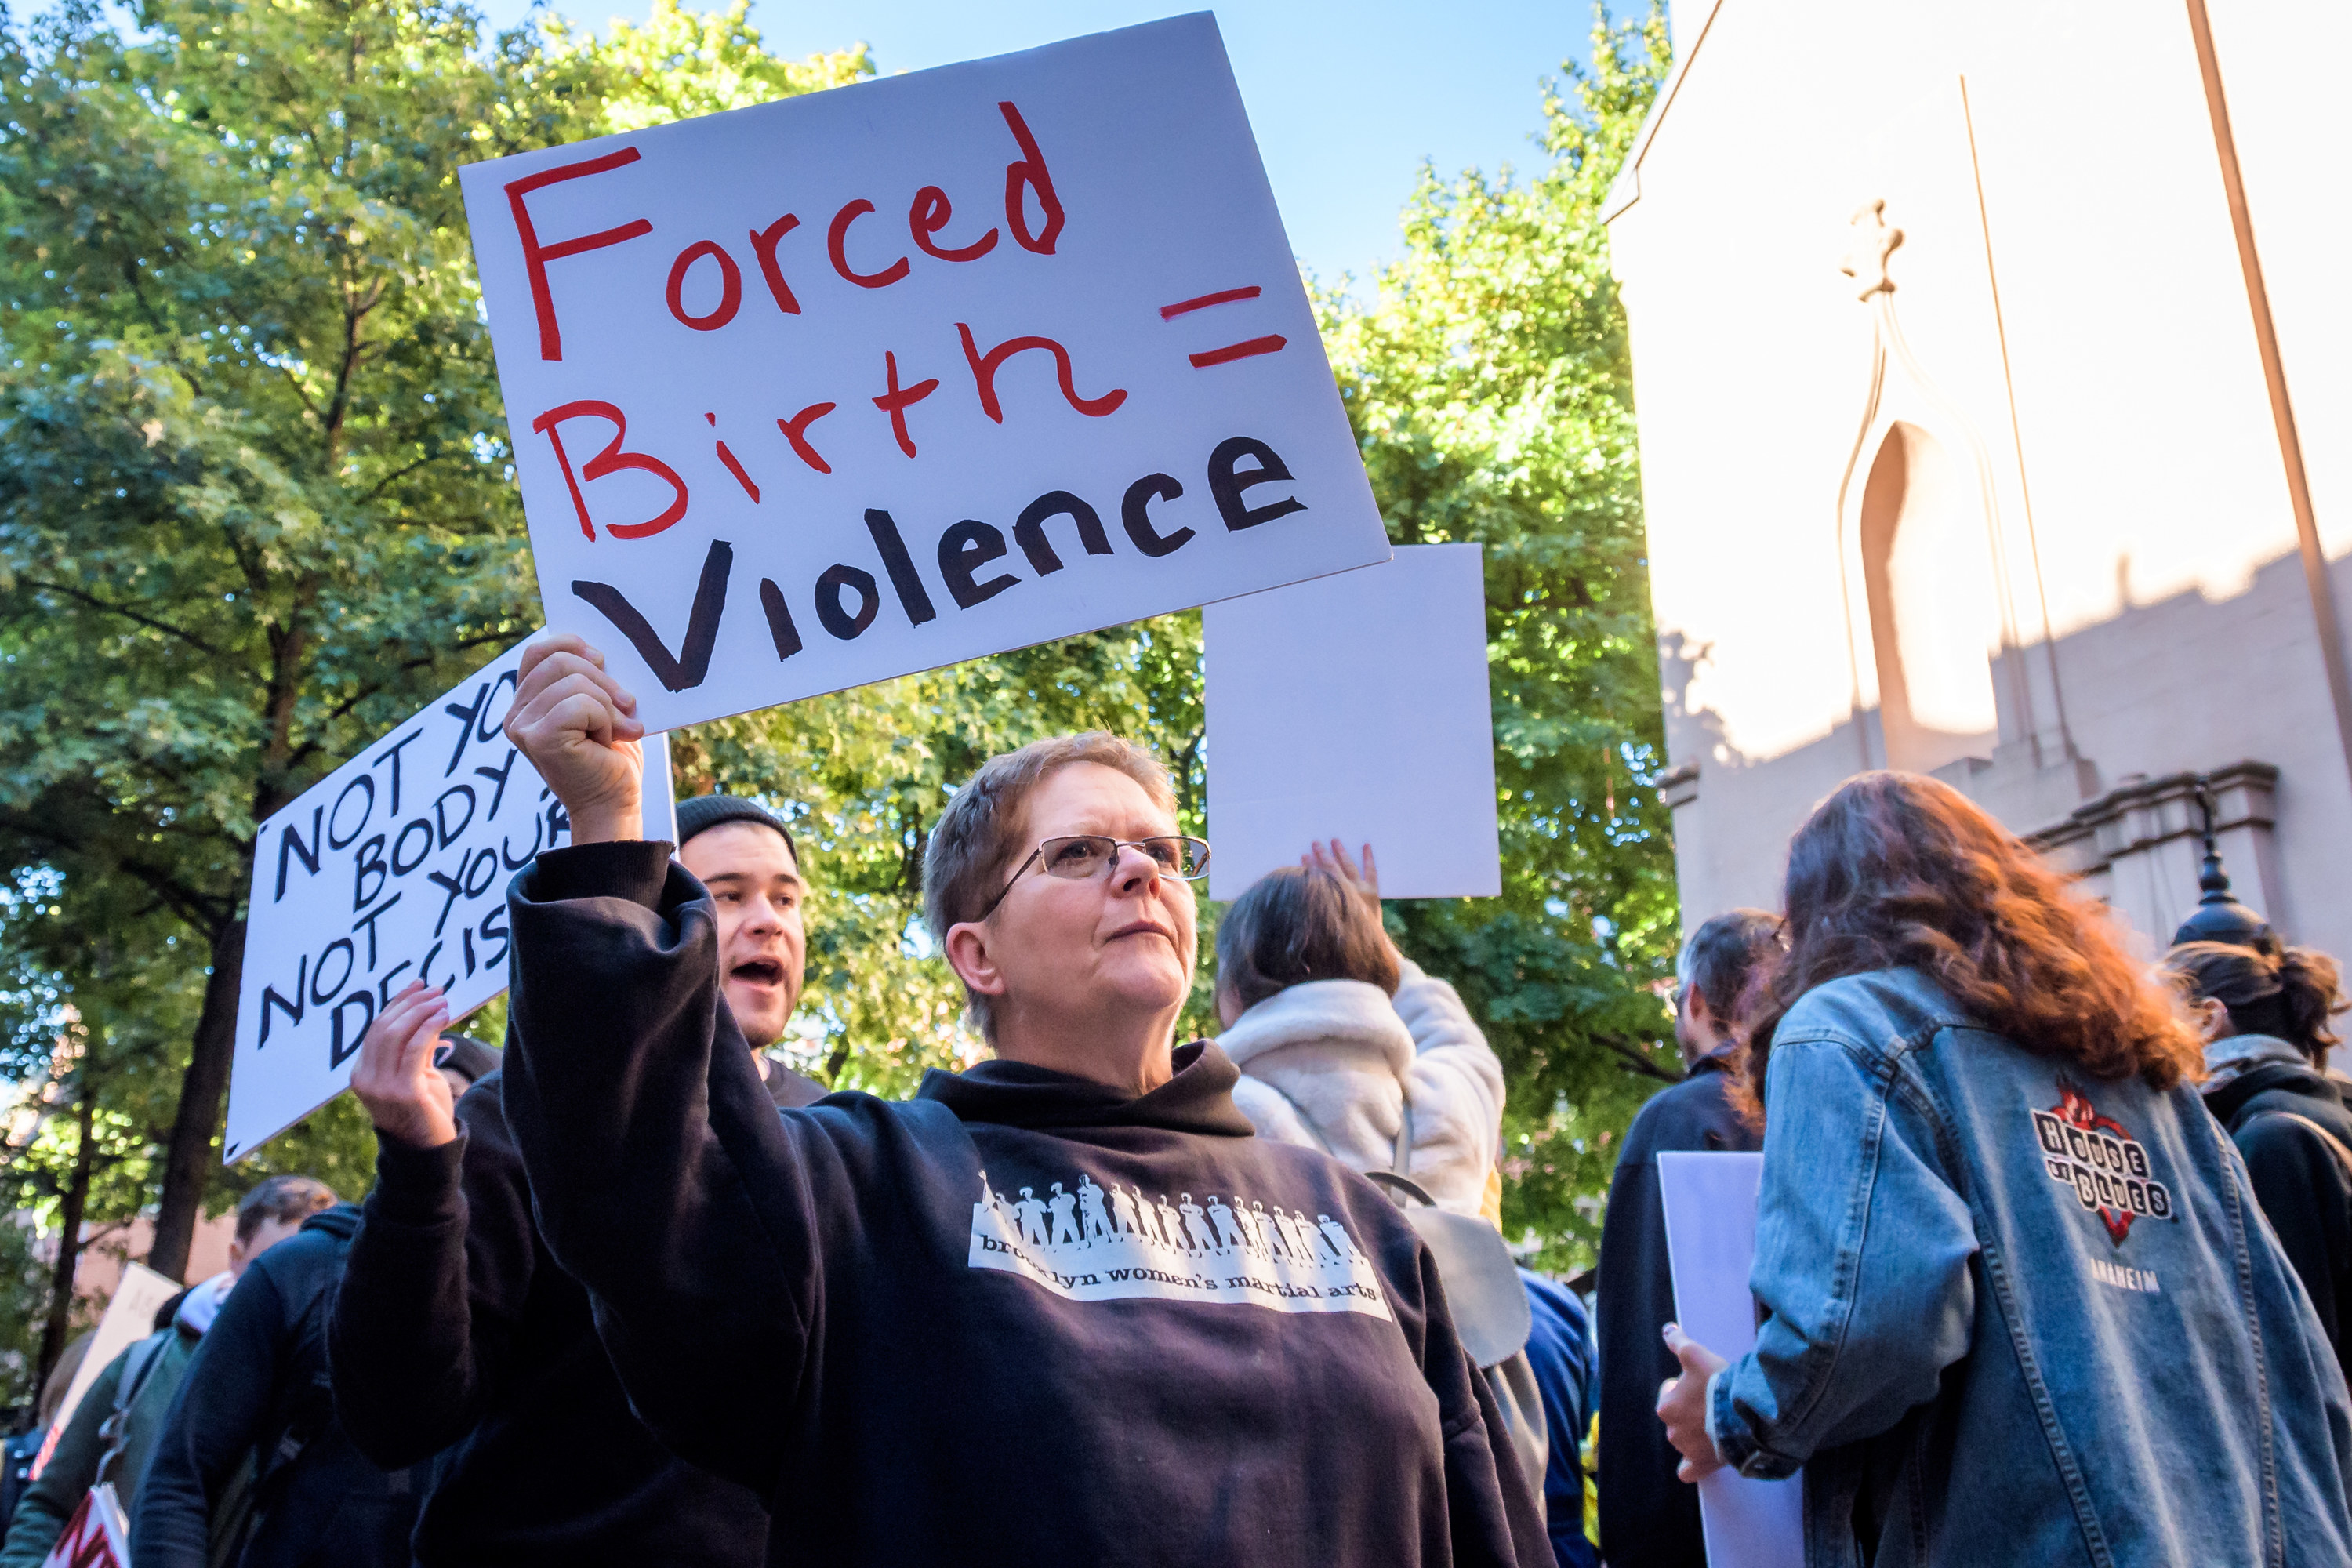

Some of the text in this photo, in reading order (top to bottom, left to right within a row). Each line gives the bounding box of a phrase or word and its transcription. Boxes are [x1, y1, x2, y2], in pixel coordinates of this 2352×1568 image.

[503, 101, 1065, 361] Forced
[532, 286, 1287, 543] Birth =
[572, 436, 1308, 693] Violence
[274, 670, 518, 903] NOT YO
[258, 892, 401, 1050] NOT
[330, 903, 510, 1072] DECIS
[2035, 1112, 2148, 1177] HOUSE
[2074, 1163, 2169, 1217] BLUES
[981, 1234, 1377, 1301] brolyn women's martial arts
[2090, 1258, 2161, 1294] ANAHEIM
